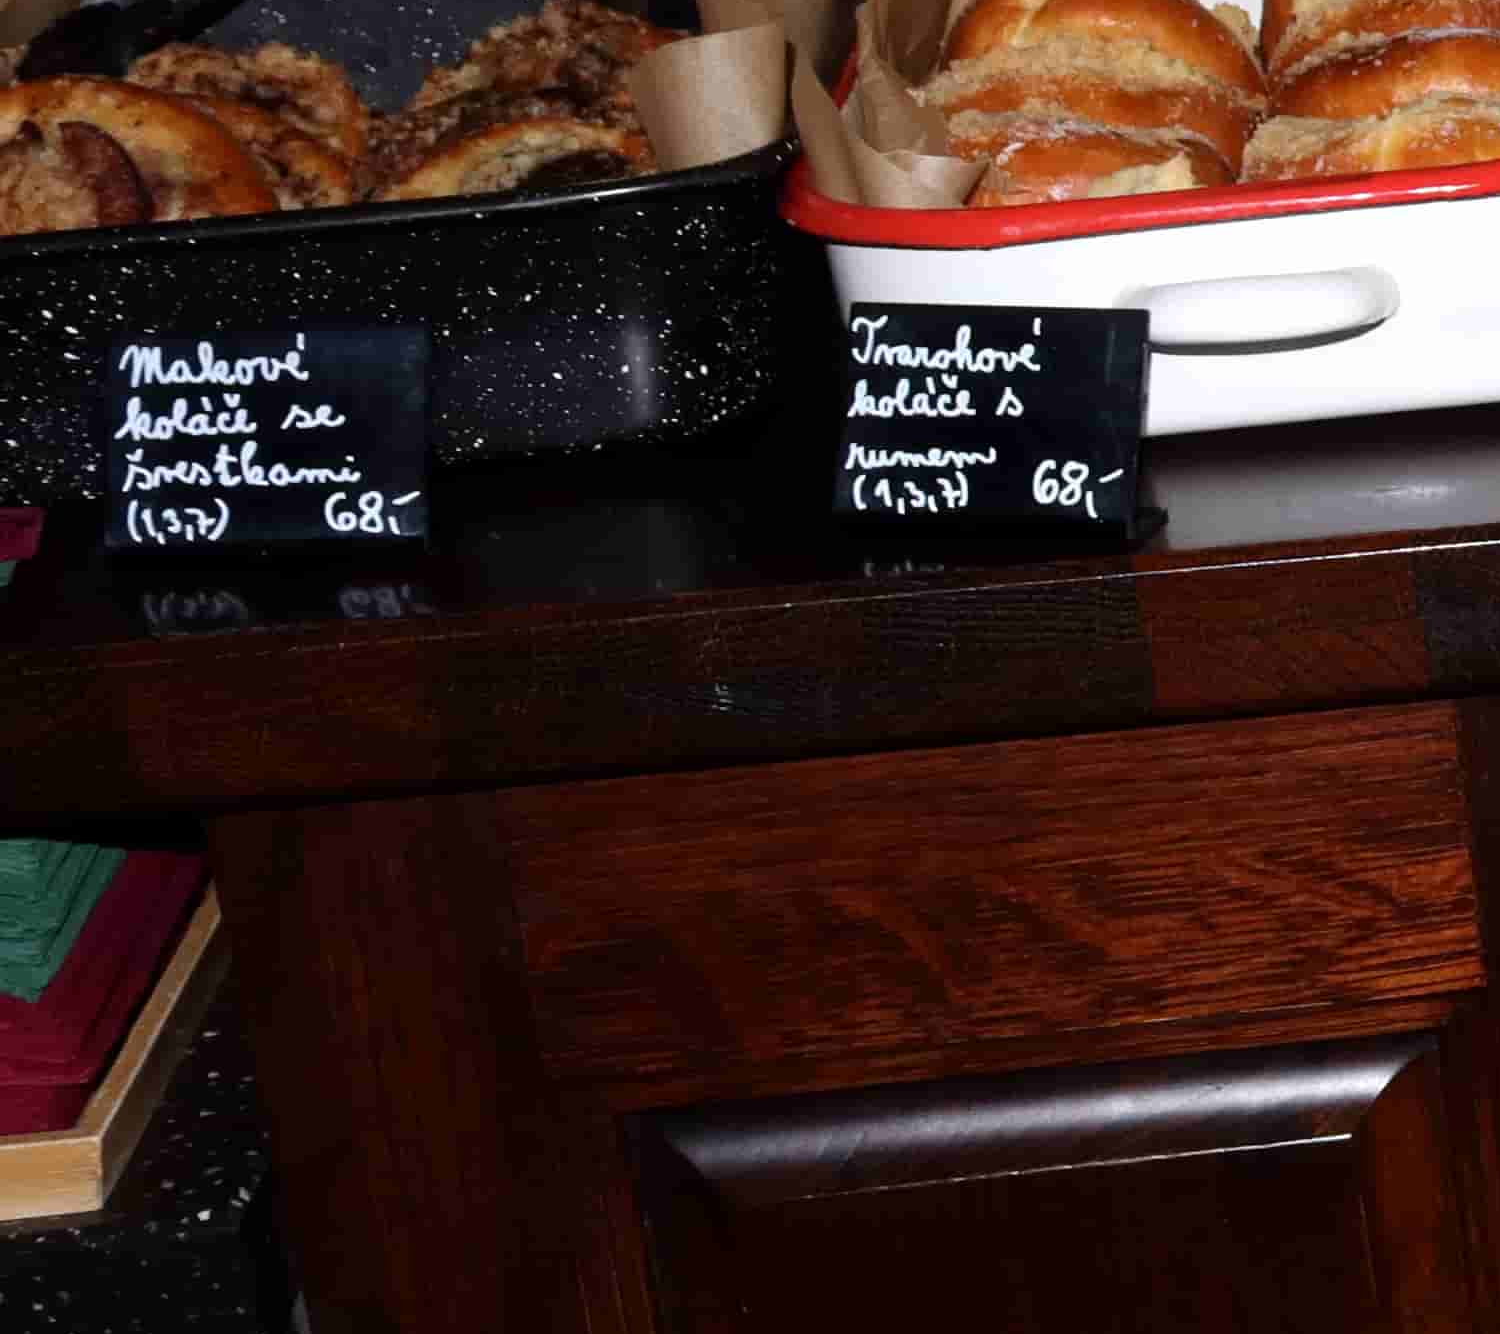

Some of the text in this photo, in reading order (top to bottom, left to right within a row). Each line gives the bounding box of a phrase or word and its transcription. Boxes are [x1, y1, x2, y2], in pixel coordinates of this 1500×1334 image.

[118, 332, 310, 389] Makové
[851, 315, 1042, 372] Tvarohové
[114, 392, 346, 442] koláče se
[847, 373, 977, 417] koláče
[122, 440, 362, 493] švestkami
